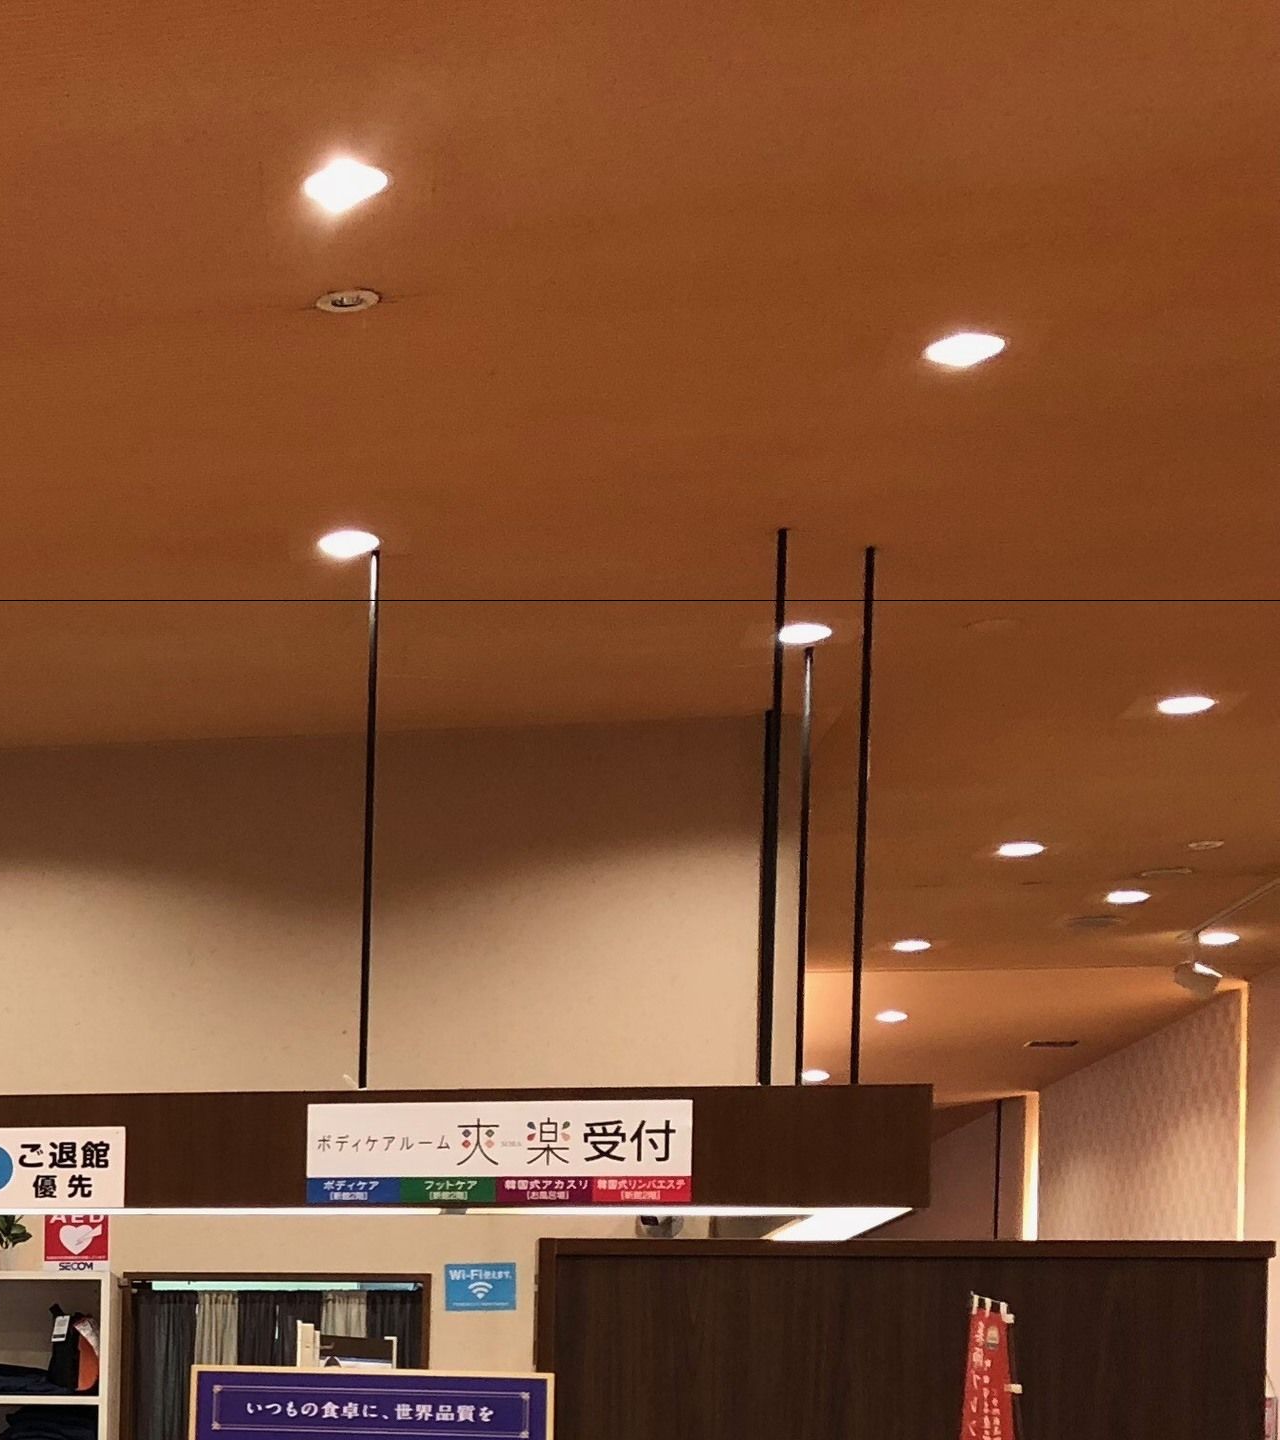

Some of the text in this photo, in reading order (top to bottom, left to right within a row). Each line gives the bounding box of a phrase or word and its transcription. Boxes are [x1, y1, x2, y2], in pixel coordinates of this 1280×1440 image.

[317, 1134, 451, 1153] ボディケアルーム
[583, 1119, 676, 1163] 受付
[18, 1140, 111, 1170] ご退館
[32, 1174, 93, 1200] 優先
[323, 1180, 380, 1191] ボディケア
[424, 1179, 478, 1191] フットケア
[48, 1214, 105, 1224] AED
[58, 1262, 94, 1271] SECOM
[246, 1400, 495, 1424] いつもの食卓に、世界品質を
